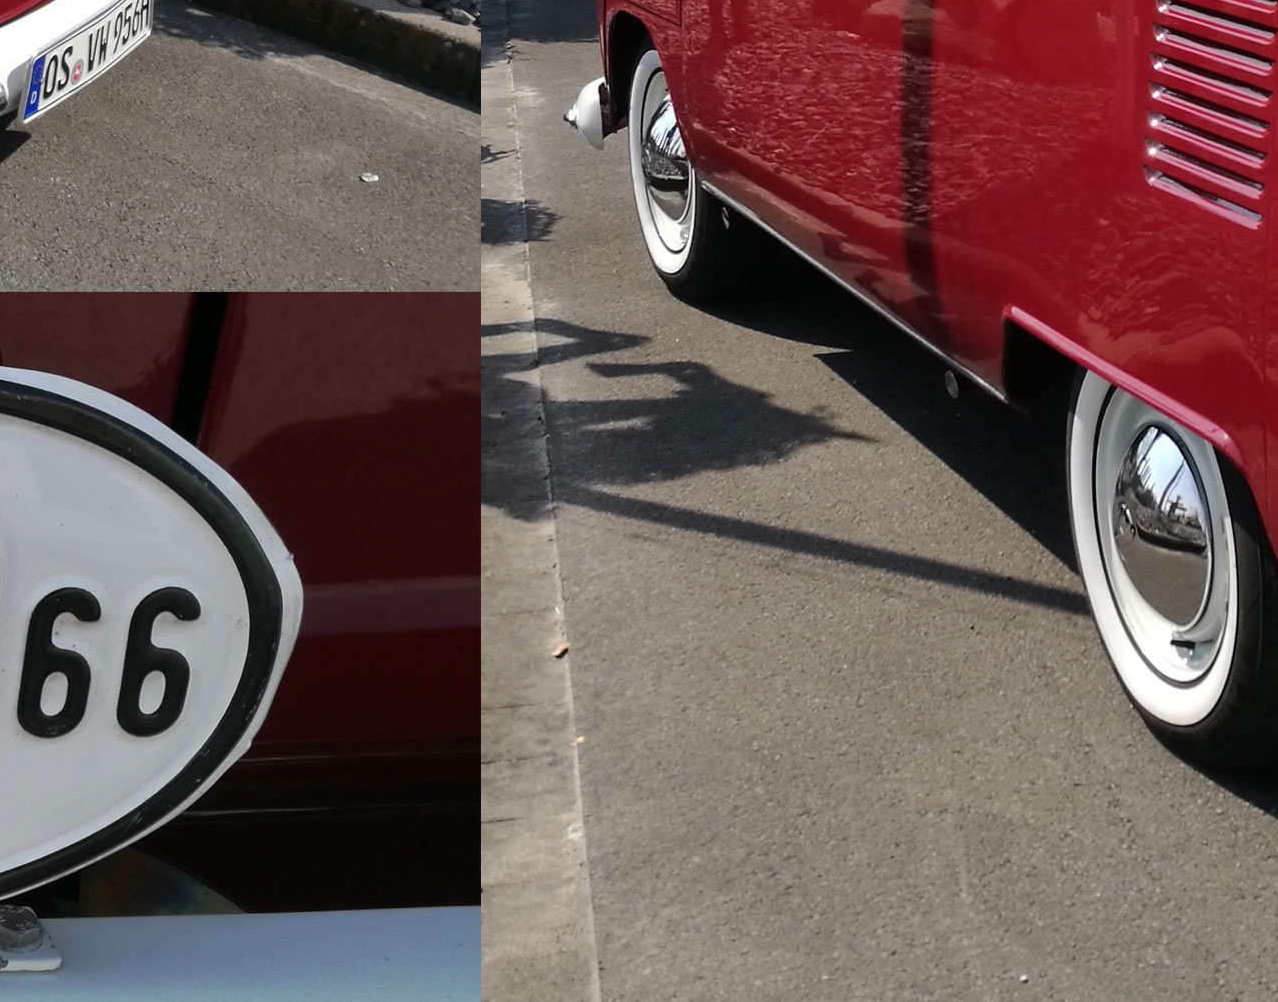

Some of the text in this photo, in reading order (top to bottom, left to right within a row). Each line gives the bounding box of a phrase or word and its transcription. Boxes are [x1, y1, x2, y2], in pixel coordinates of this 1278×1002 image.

[30, 90, 38, 105] D
[43, 45, 73, 100] OS
[87, 20, 111, 73] VW
[16, 586, 202, 739] 66
